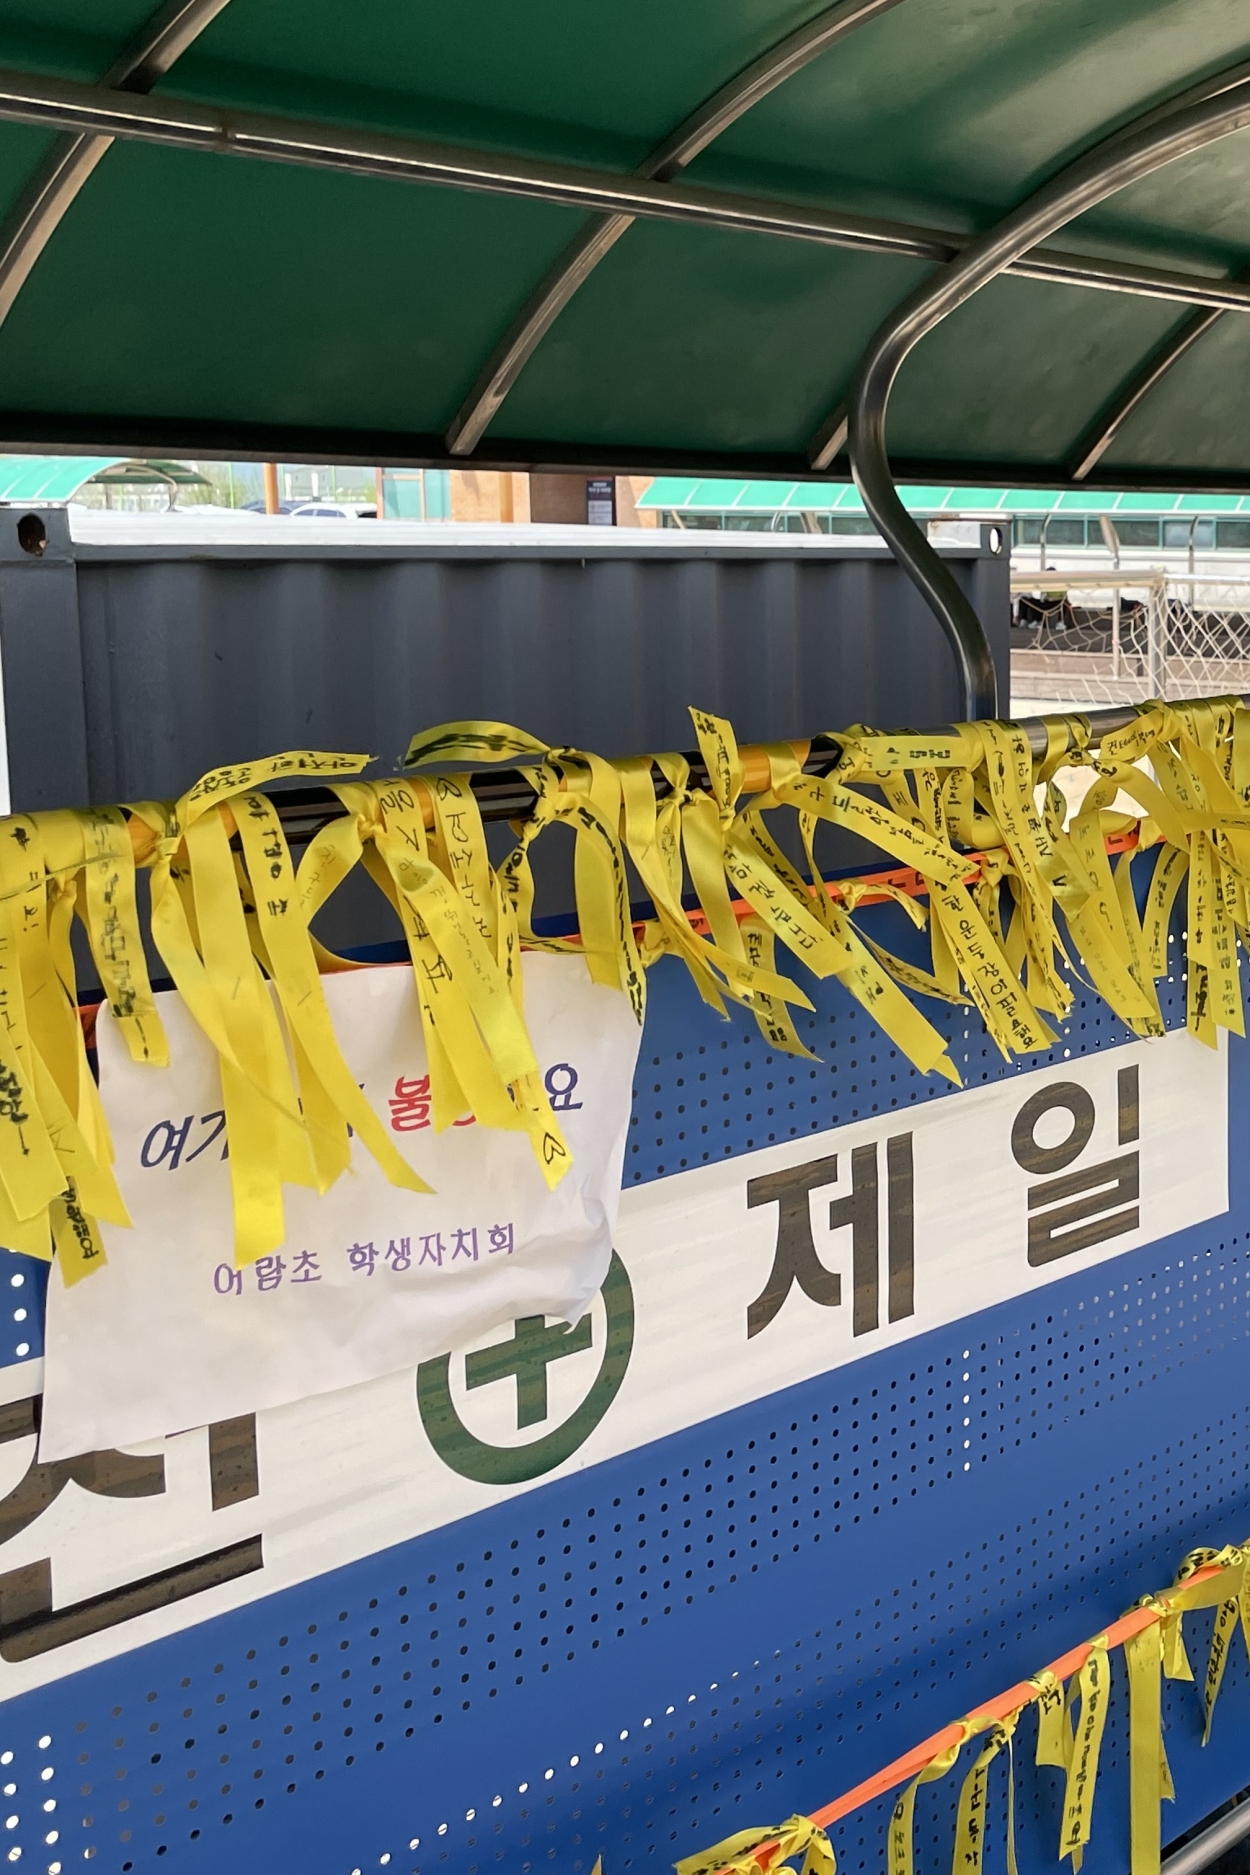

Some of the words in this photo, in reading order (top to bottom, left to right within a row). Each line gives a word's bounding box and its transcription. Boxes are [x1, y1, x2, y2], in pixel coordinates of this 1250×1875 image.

[213, 1250, 323, 1296] 어람초
[347, 1222, 516, 1278] 학생자치회
[747, 1063, 1141, 1340] 제일
